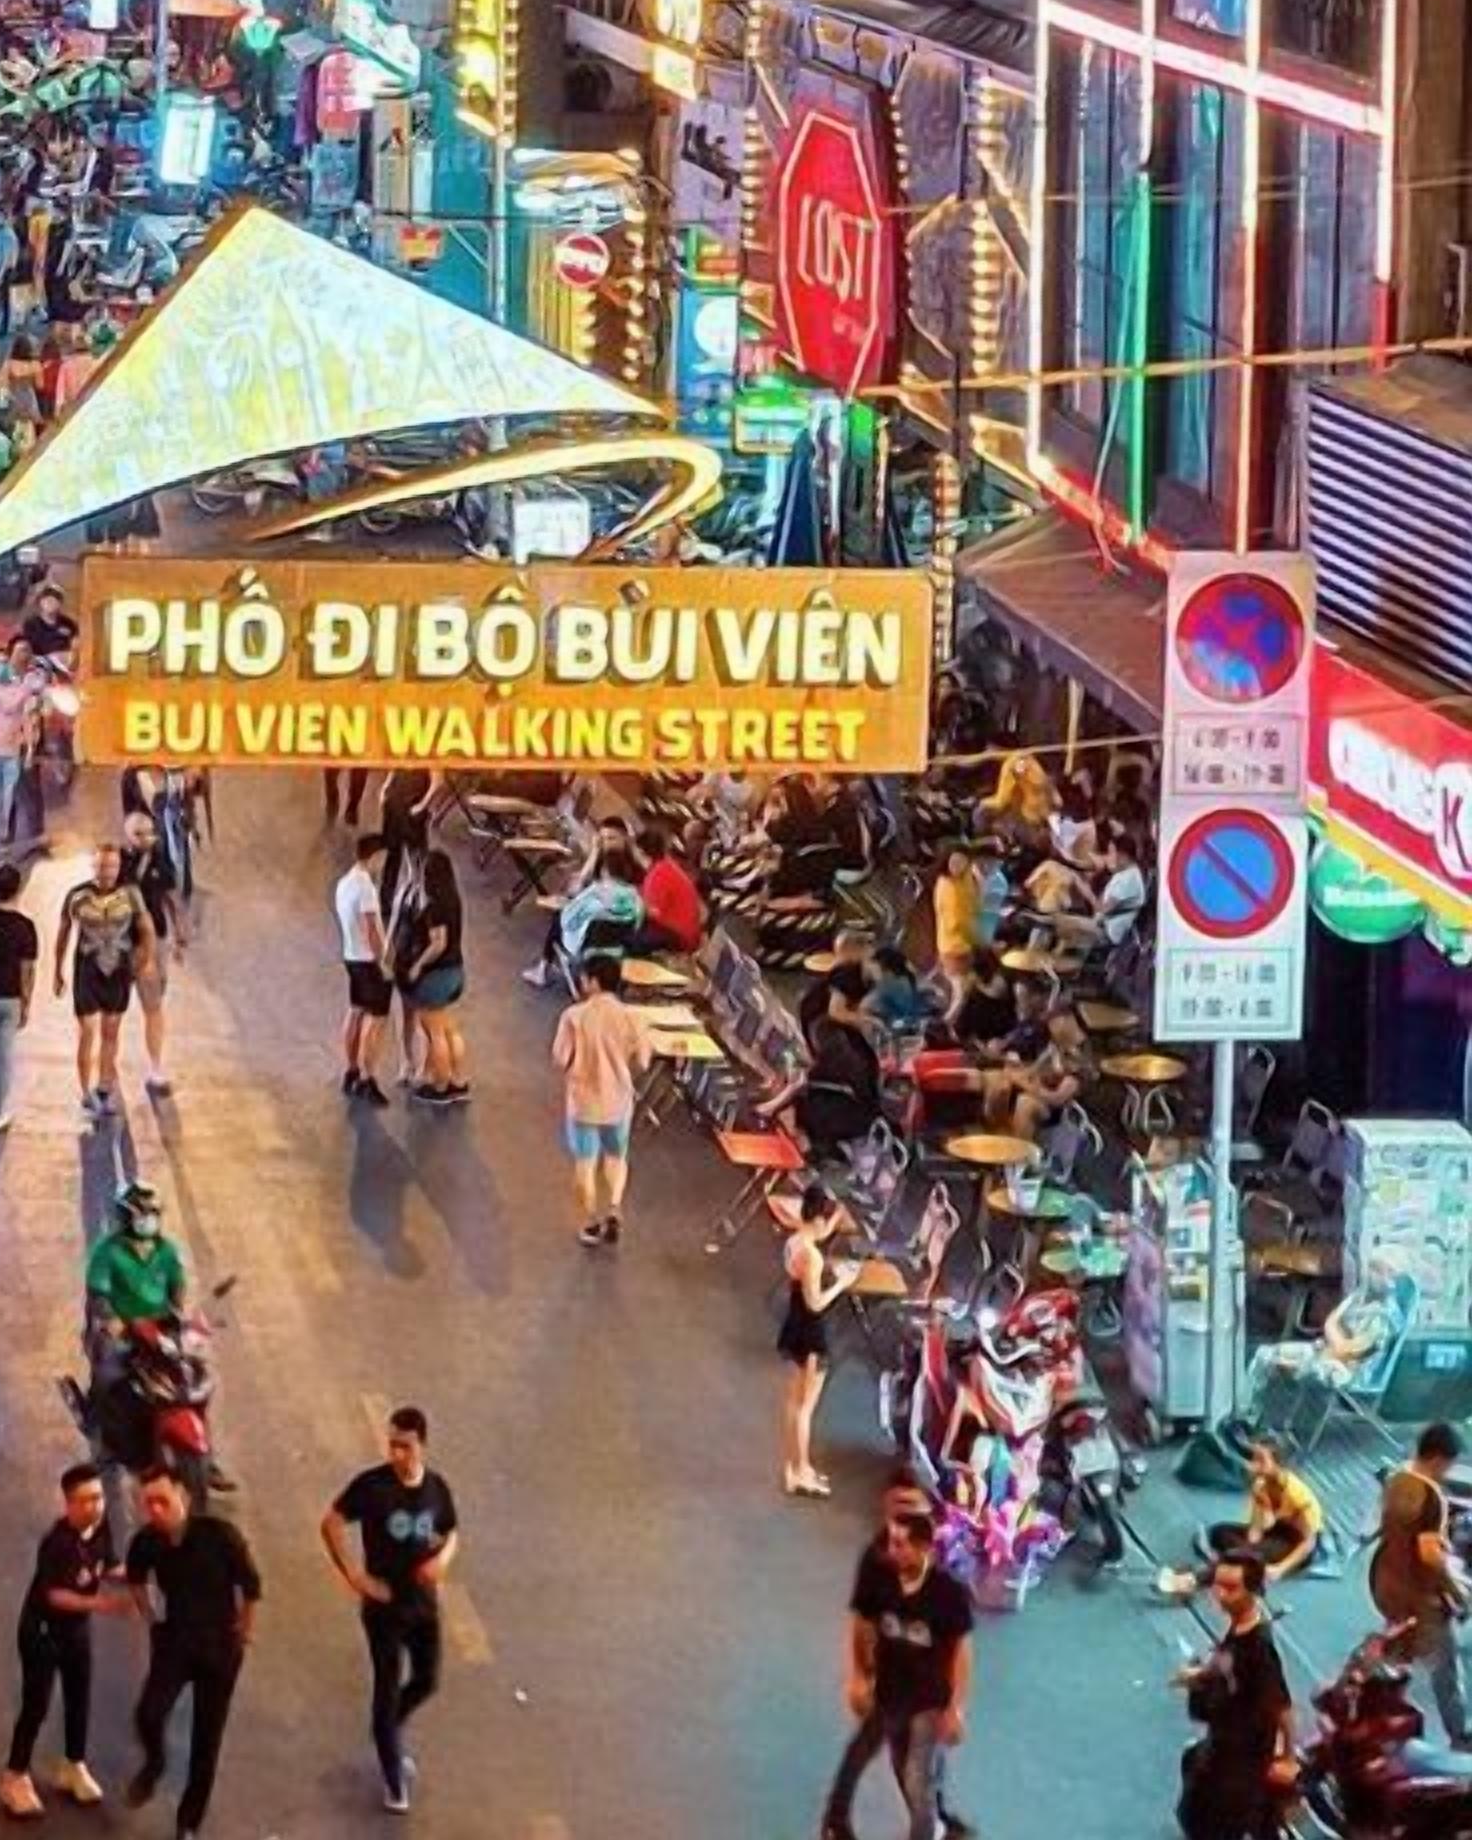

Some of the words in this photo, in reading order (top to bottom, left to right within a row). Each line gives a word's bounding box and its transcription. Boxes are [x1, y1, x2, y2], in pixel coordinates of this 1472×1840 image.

[109, 566, 286, 678] PHỐ
[307, 602, 399, 678] ĐI
[416, 584, 537, 697] BỘ
[555, 579, 698, 682] BÙI
[715, 587, 902, 684] VIÊN
[124, 701, 225, 755] BUI
[235, 703, 369, 757] VIEN
[383, 705, 645, 760] WALKING
[654, 708, 867, 763] STREET
